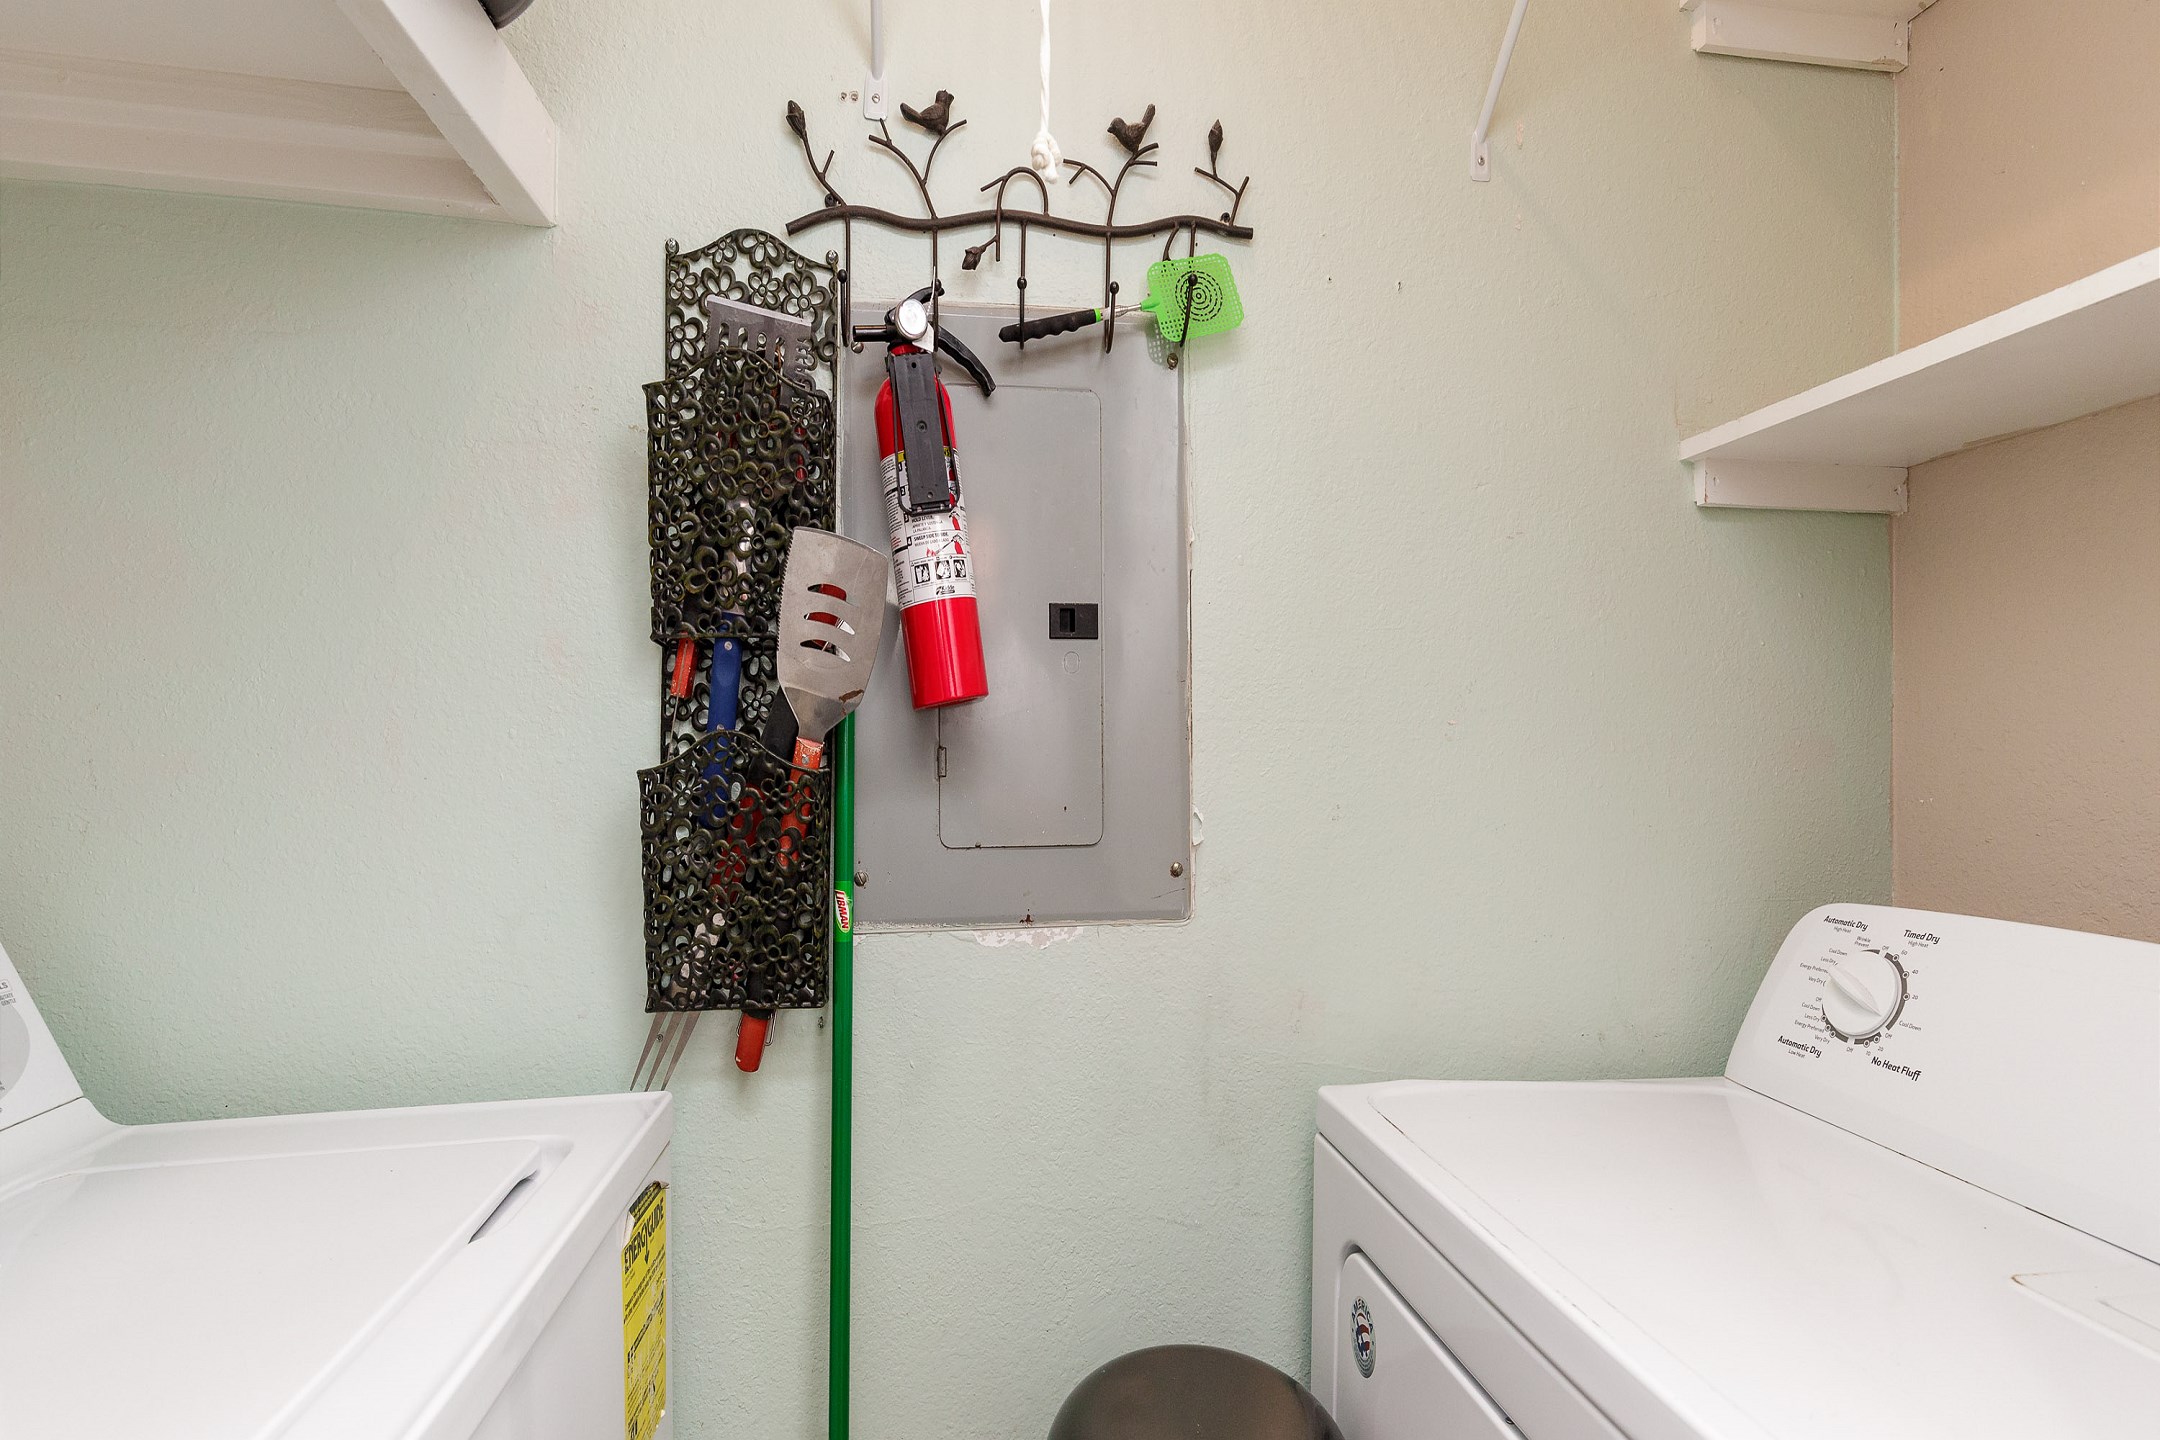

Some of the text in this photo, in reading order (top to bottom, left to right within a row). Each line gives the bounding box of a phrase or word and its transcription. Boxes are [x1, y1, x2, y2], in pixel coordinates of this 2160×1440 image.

[1823, 915, 1869, 932] Automatic Dry
[1856, 935, 1871, 943] Wrinkle
[1904, 929, 1941, 945] Timed Dry
[1854, 940, 1870, 948] Prevent
[1800, 962, 1812, 970] Energy
[1809, 1004, 1821, 1012] Down
[1812, 1015, 1820, 1023] Dry
[1794, 1019, 1825, 1034] Energy Preferred
[1898, 1020, 1922, 1031] Cool Down
[1814, 1034, 1830, 1045] Very Dry
[1777, 1035, 1822, 1059] Automatic Dry
[1871, 1056, 1922, 1082] No Heat Fluff
